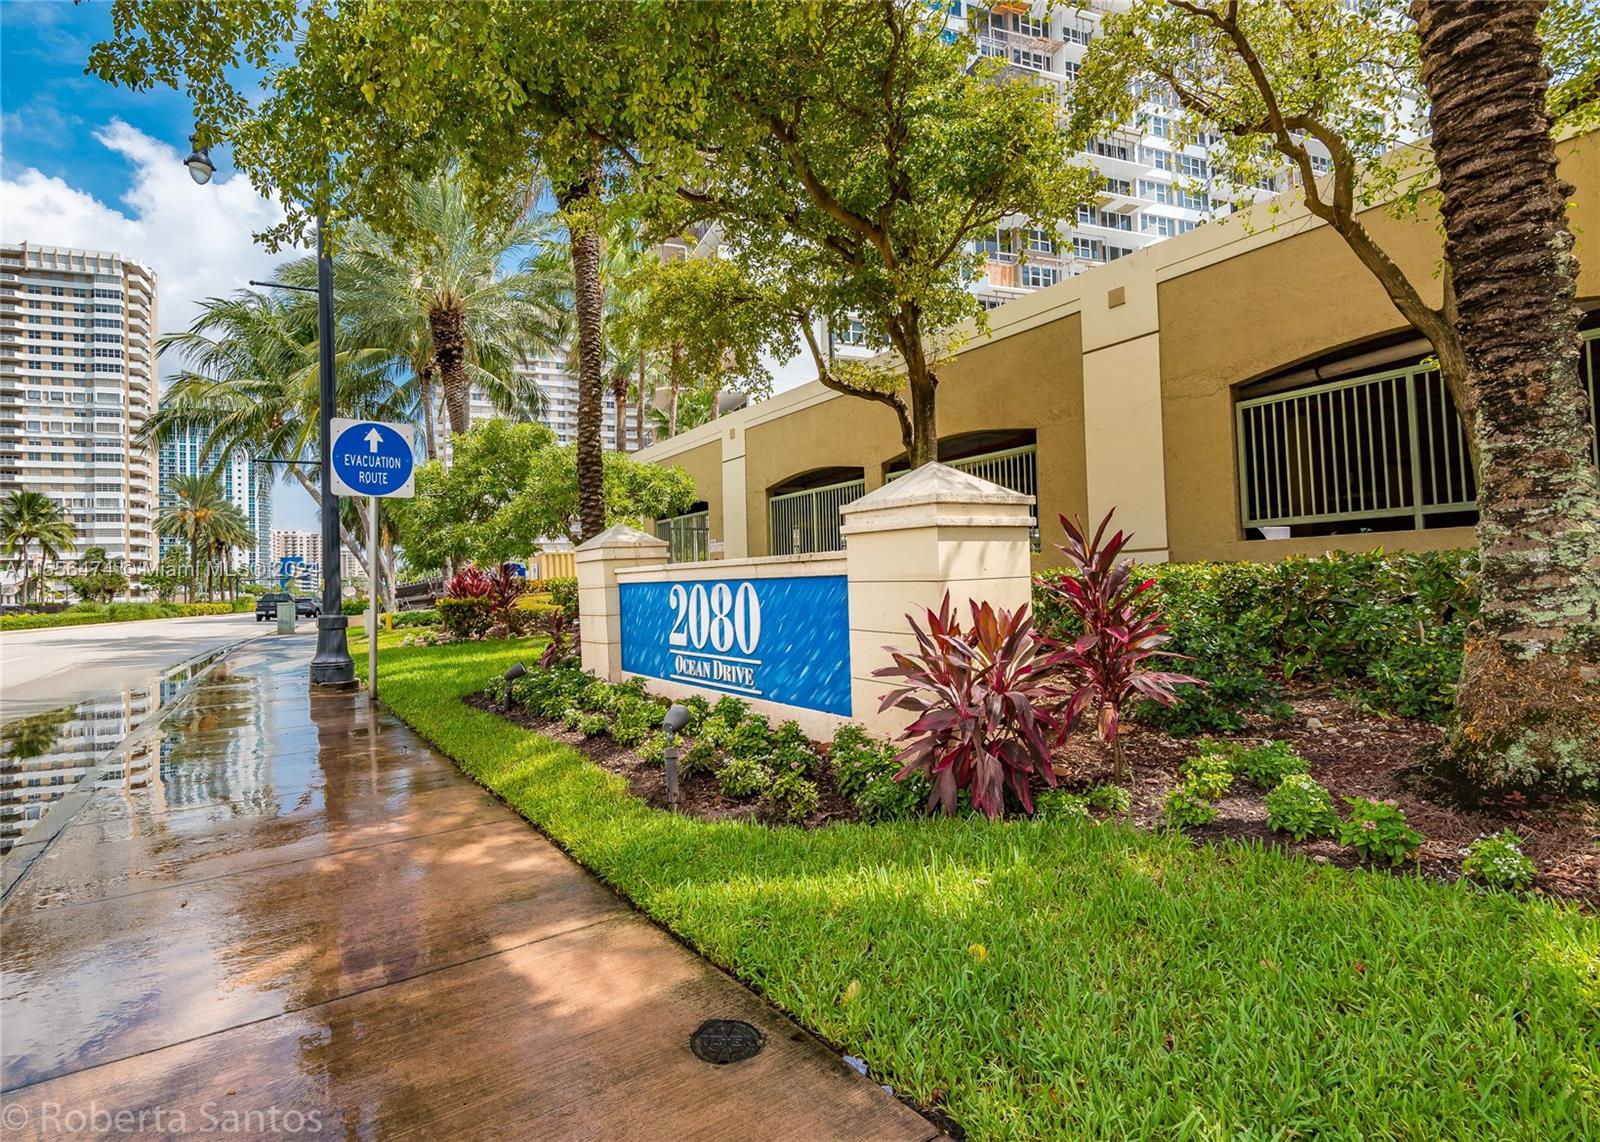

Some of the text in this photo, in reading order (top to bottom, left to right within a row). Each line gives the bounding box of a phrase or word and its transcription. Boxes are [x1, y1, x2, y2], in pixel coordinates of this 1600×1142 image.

[344, 453, 402, 469] EVACUATION
[358, 471, 389, 486] ROUTE
[669, 582, 761, 655] 2080
